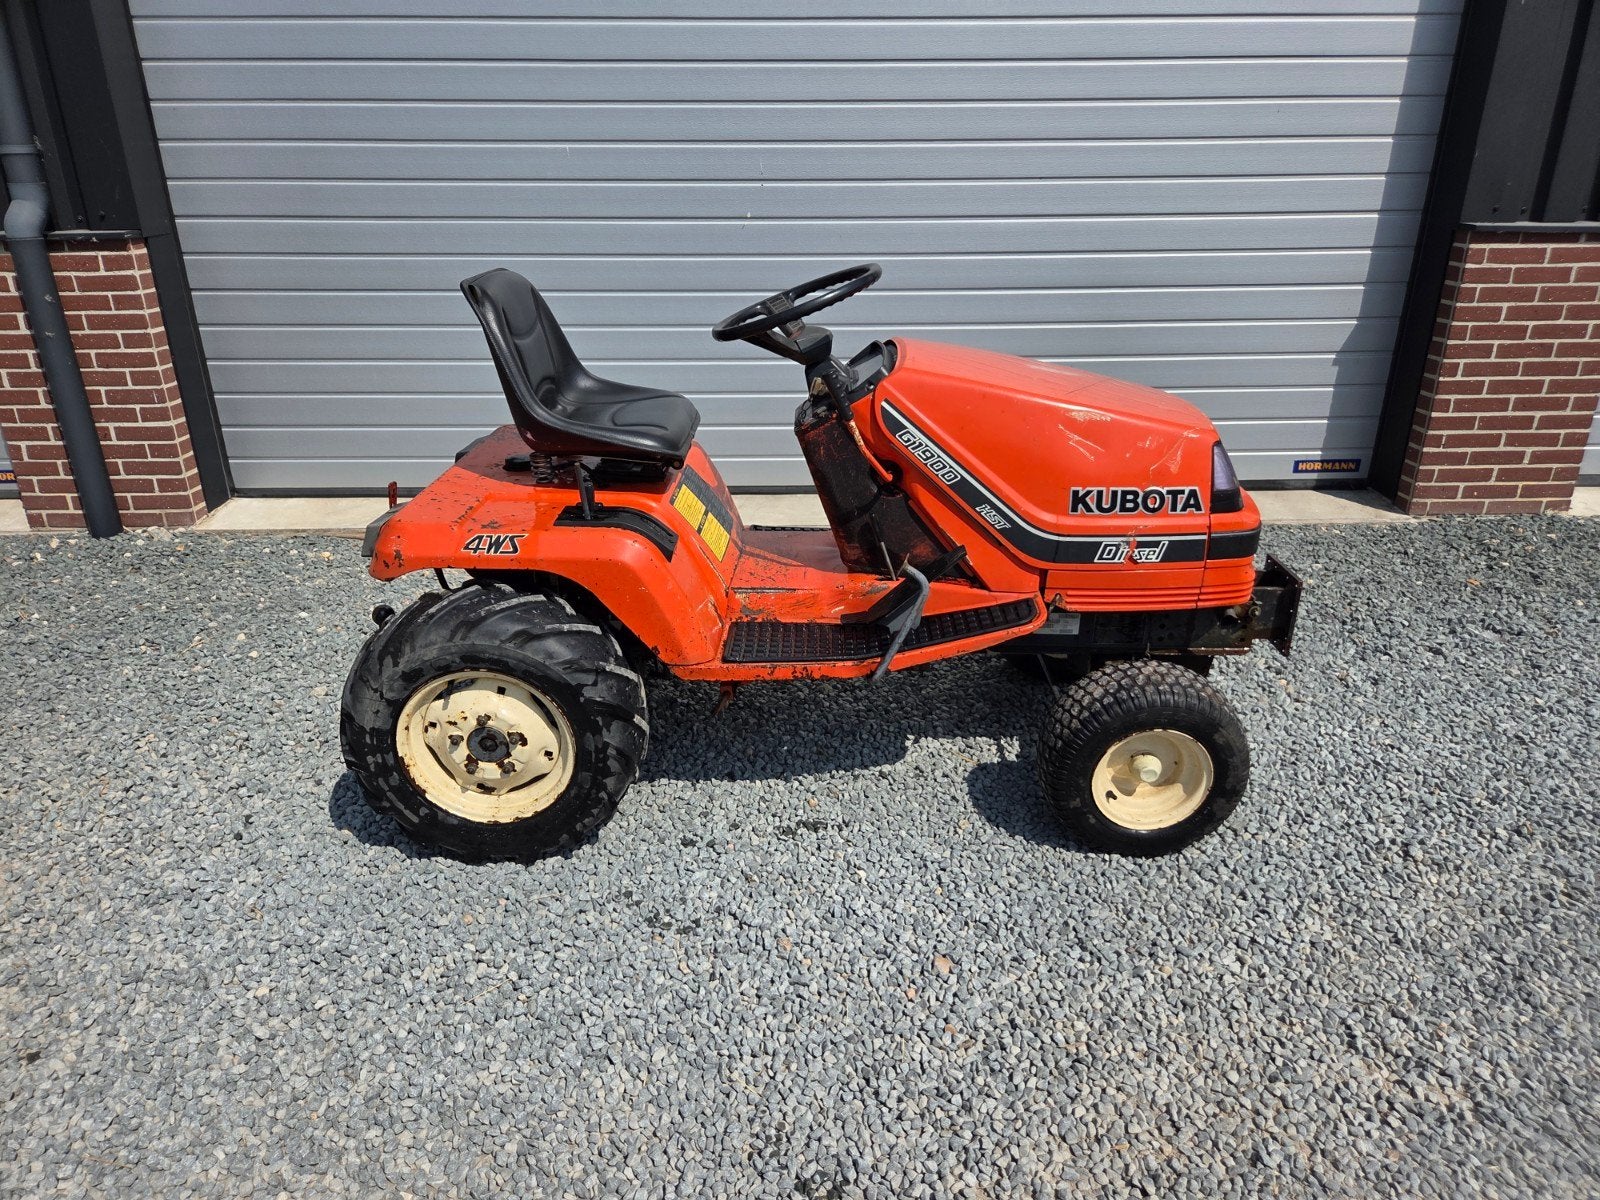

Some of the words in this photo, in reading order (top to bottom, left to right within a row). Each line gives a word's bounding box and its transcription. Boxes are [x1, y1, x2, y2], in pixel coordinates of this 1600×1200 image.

[896, 428, 961, 485] G1900
[1069, 486, 1205, 515] KUBOTA
[975, 503, 1011, 530] HST
[461, 533, 529, 555] 4WS
[1094, 541, 1169, 563] Disel
